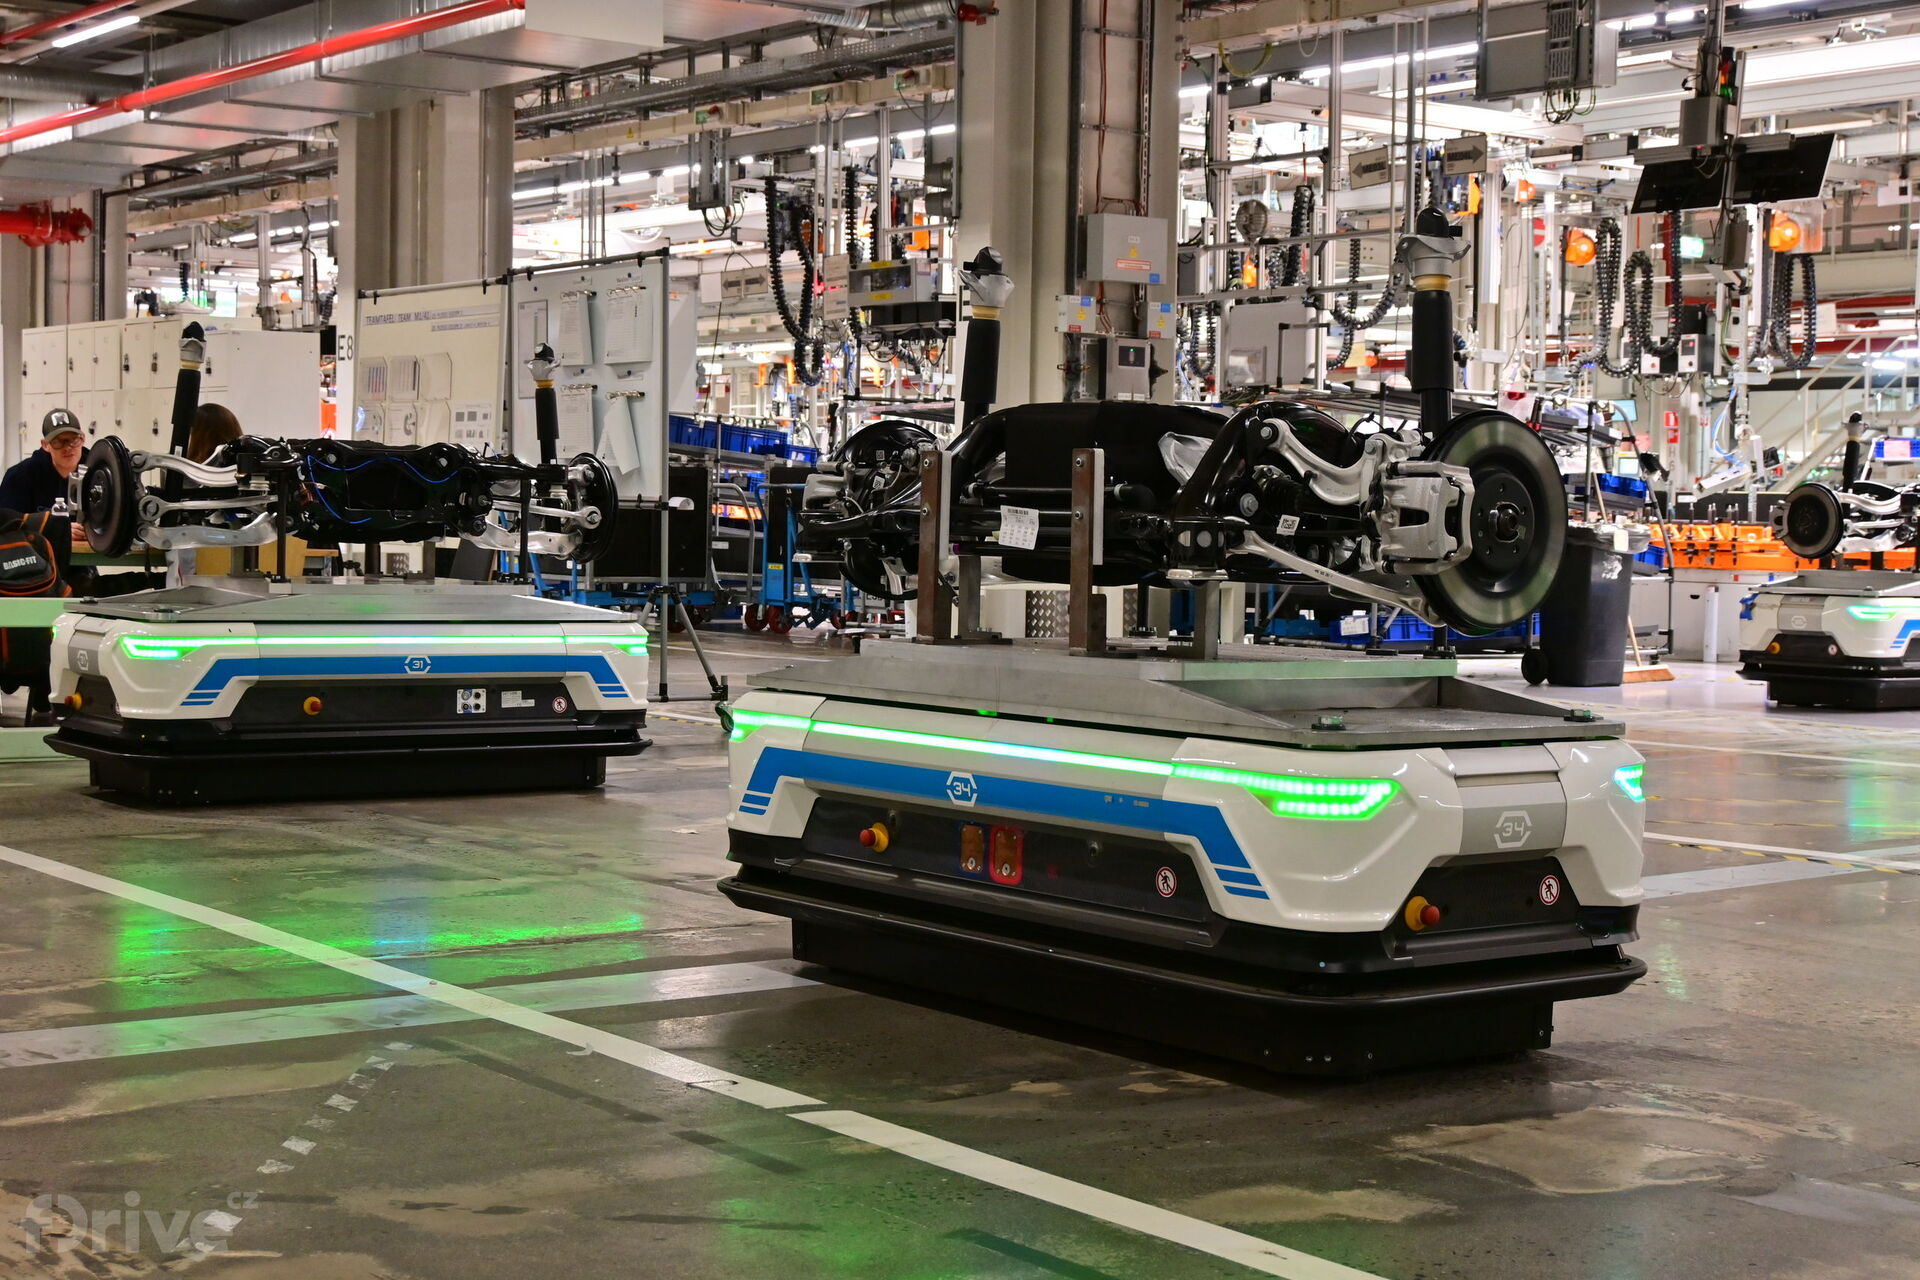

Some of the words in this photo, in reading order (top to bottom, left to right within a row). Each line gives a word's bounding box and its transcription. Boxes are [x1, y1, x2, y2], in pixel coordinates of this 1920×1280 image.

[337, 334, 354, 361] E8
[3, 556, 37, 570] BASIC-FIT
[412, 659, 425, 669] 31
[953, 781, 972, 798] 34
[1502, 821, 1525, 837] 34
